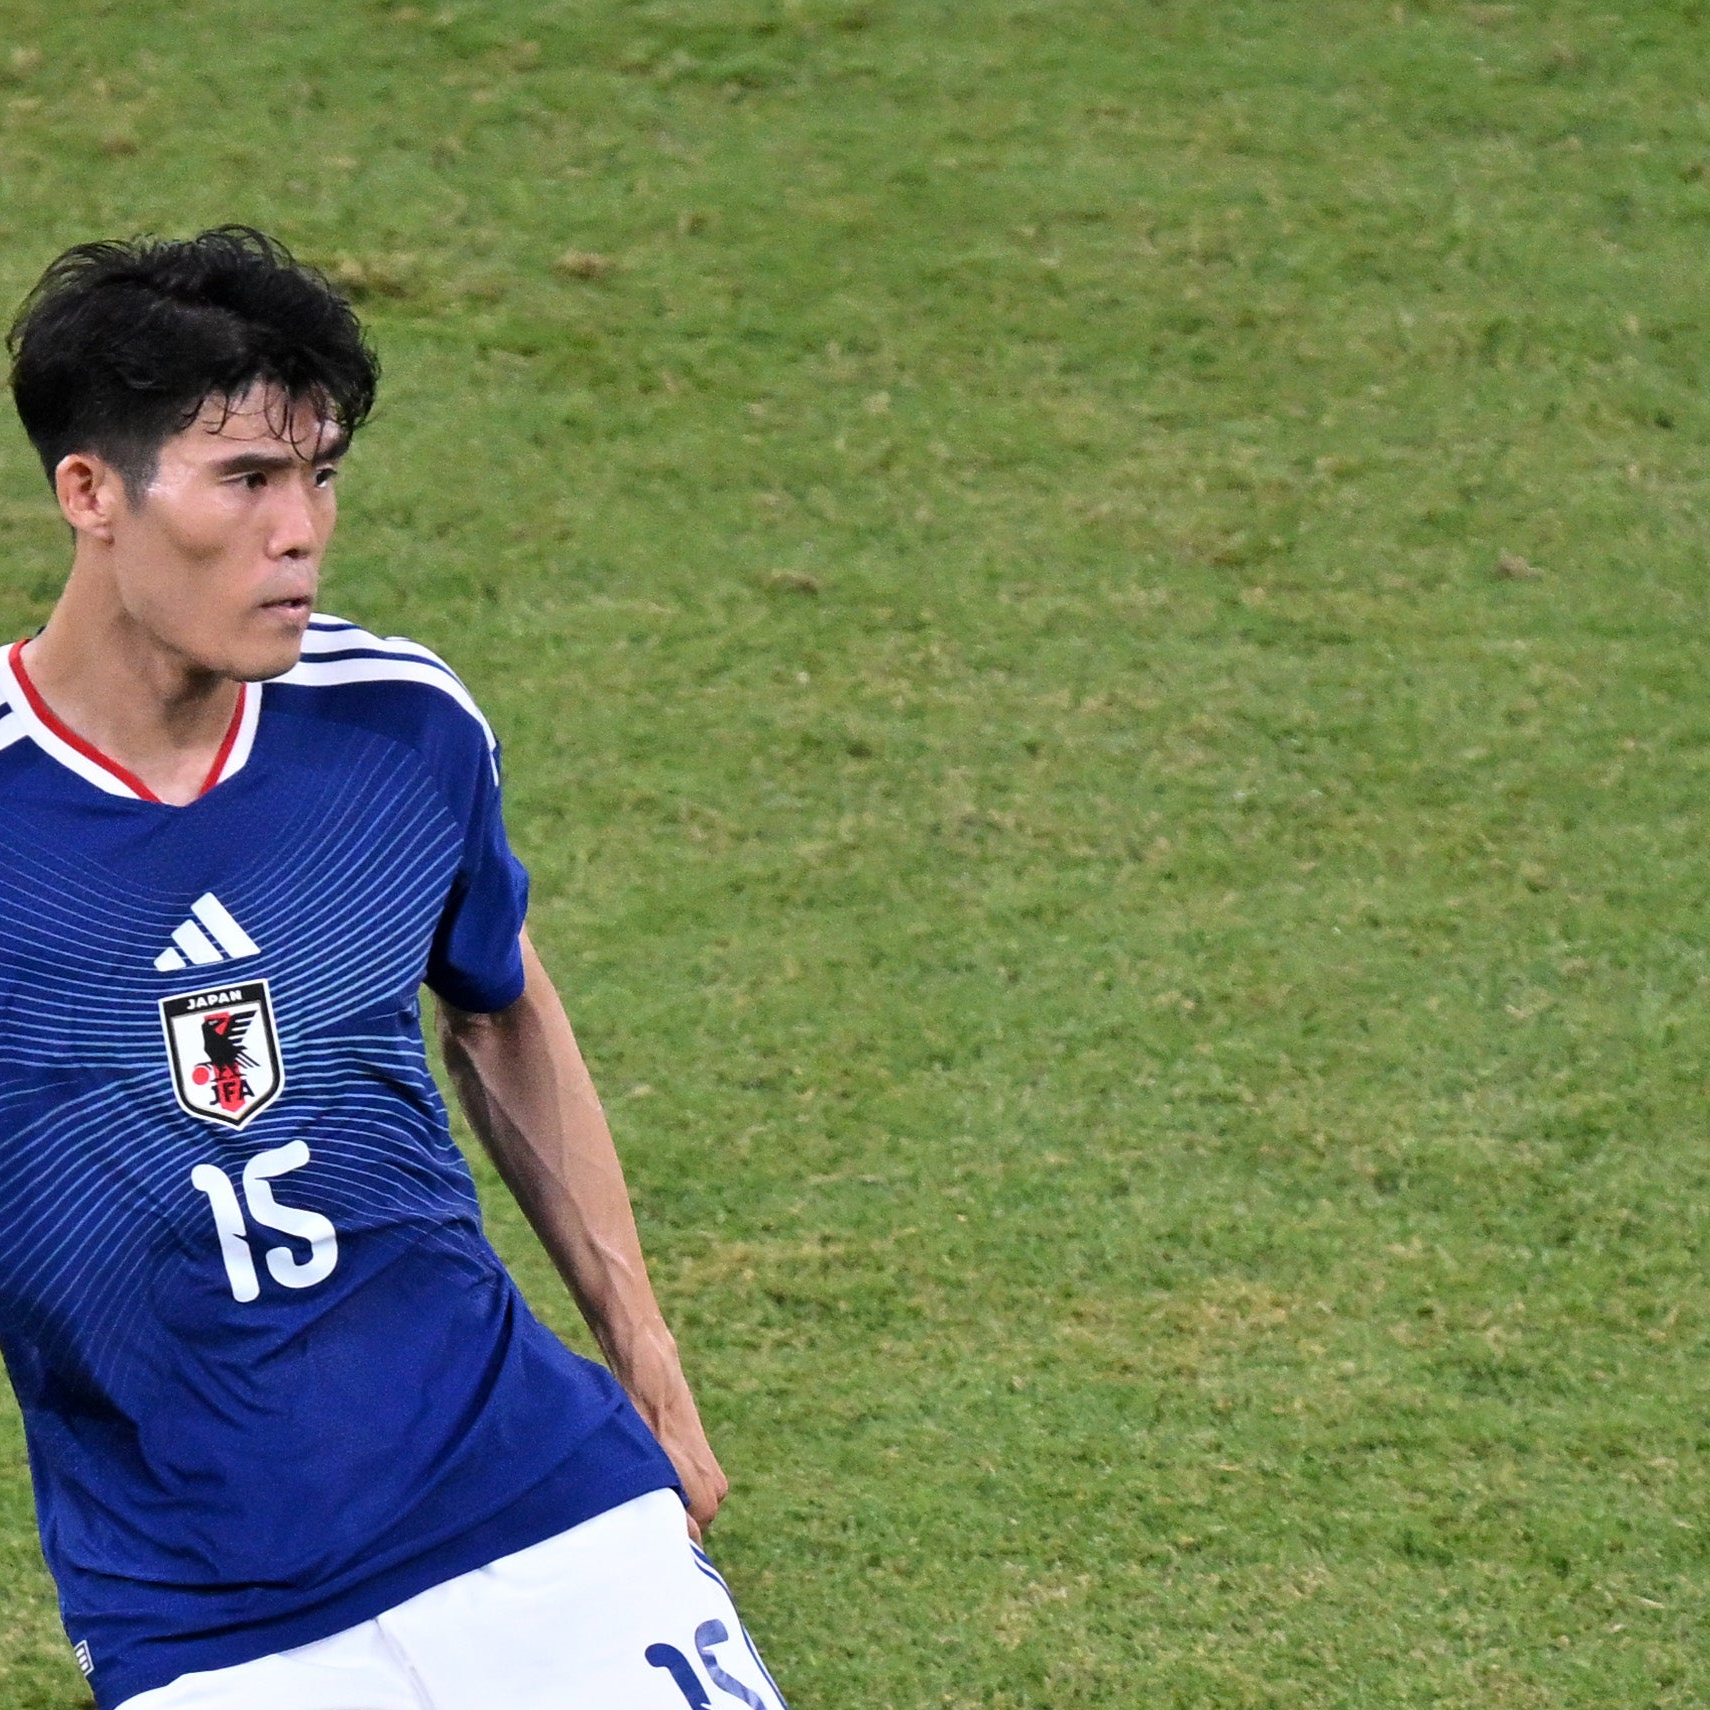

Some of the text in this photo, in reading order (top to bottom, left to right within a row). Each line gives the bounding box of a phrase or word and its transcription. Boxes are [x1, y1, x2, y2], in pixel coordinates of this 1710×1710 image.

[186, 989, 243, 1010] JAPAN
[209, 1079, 255, 1106] JFA
[191, 1139, 338, 1303] 15
